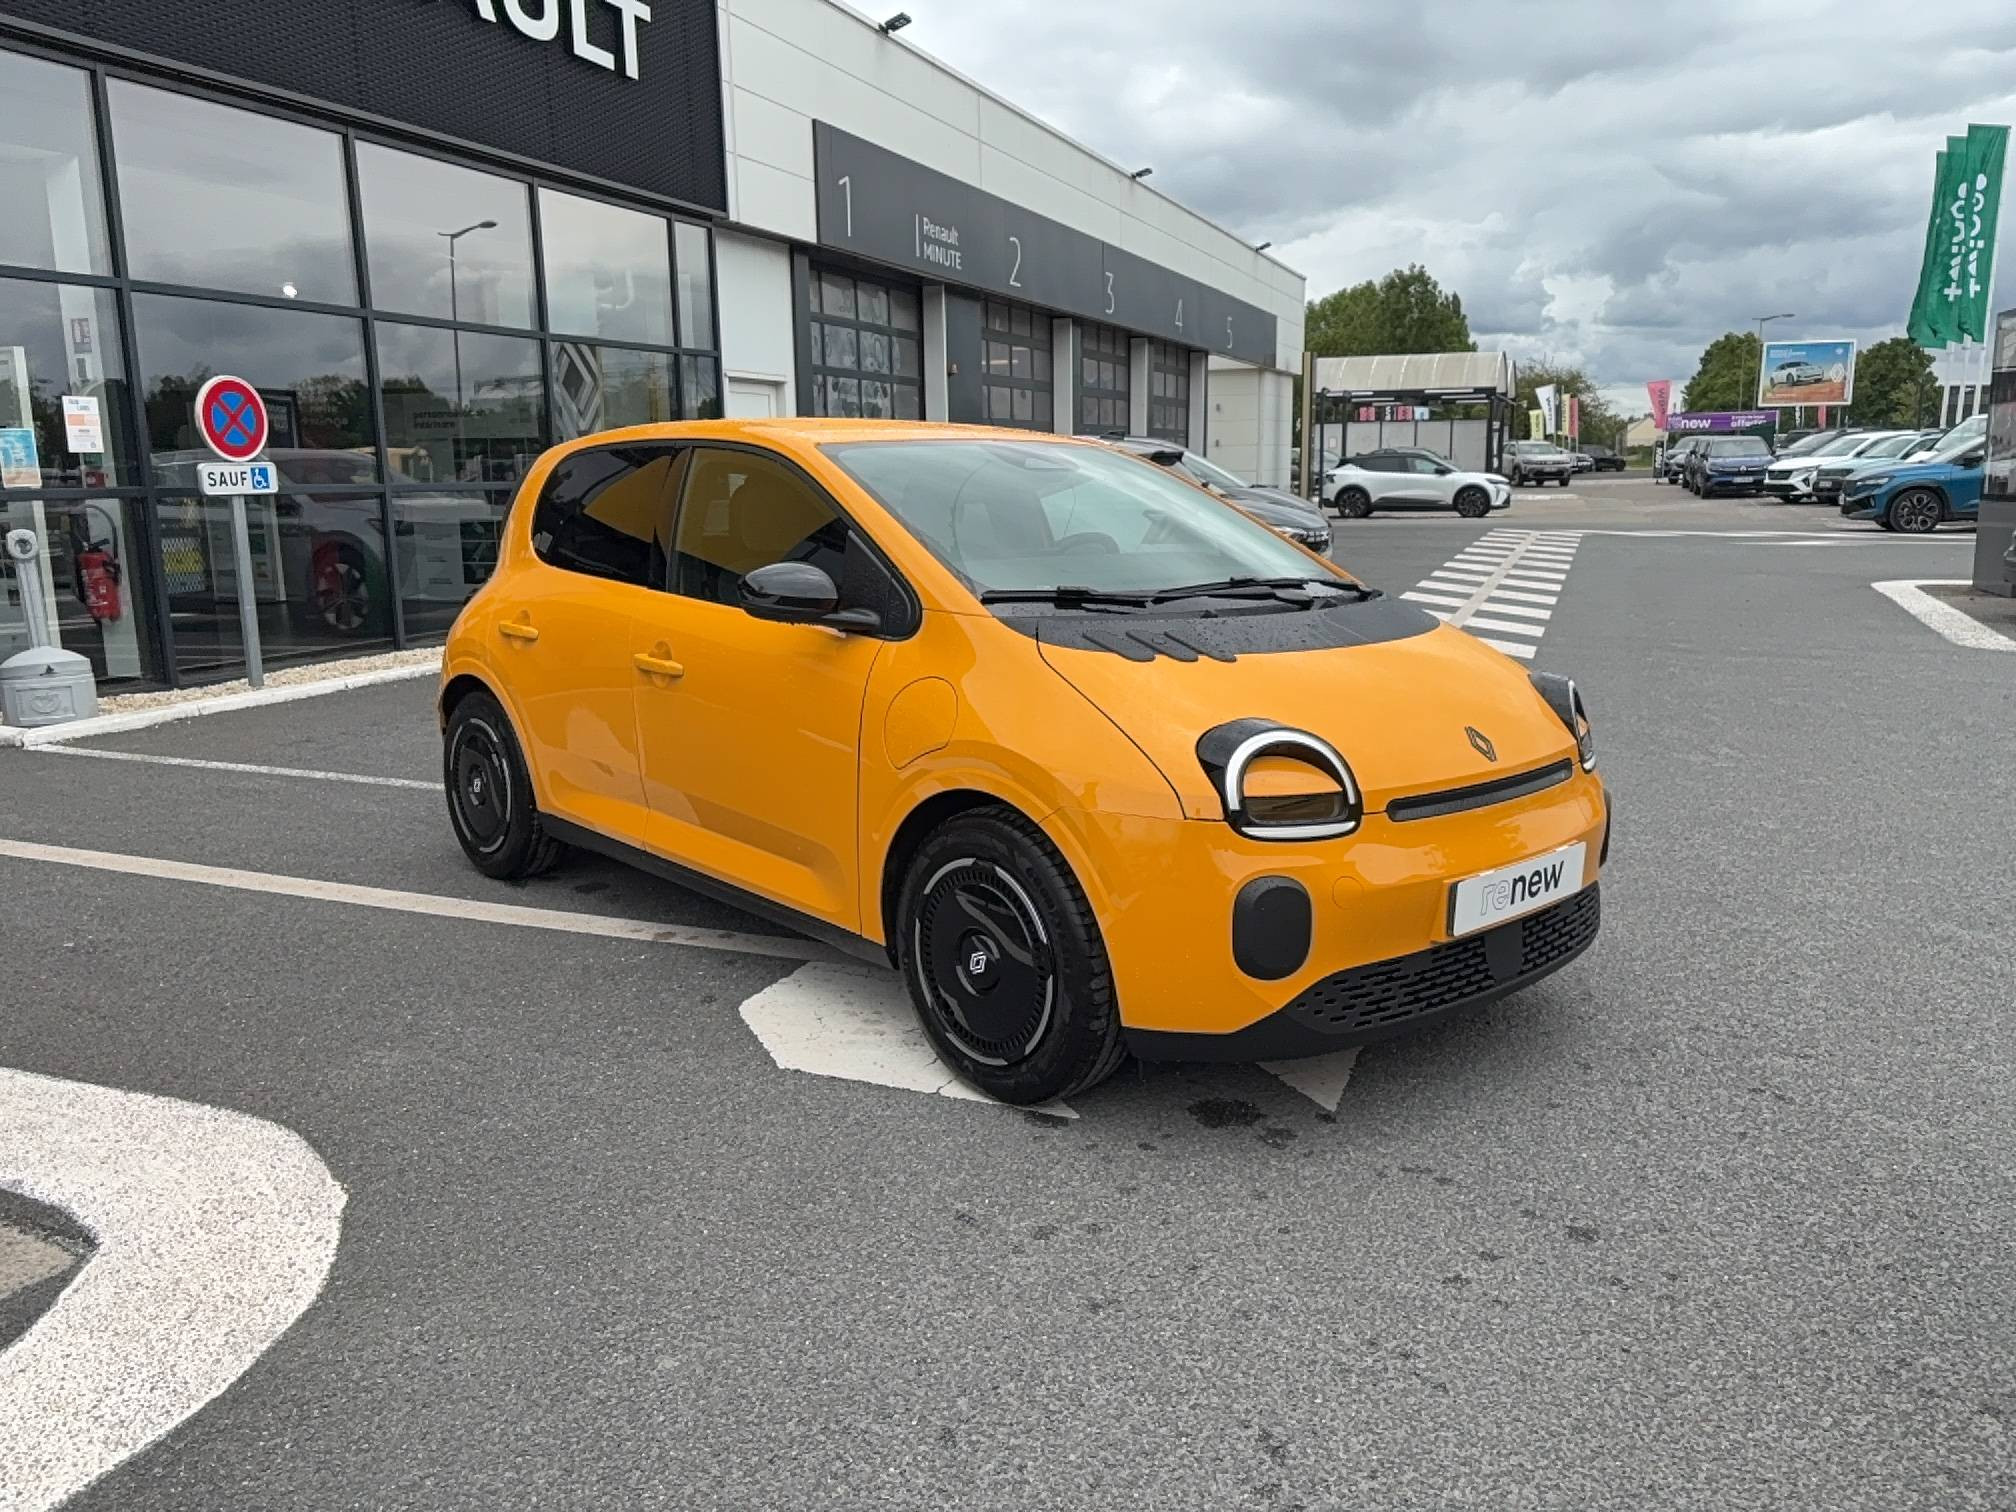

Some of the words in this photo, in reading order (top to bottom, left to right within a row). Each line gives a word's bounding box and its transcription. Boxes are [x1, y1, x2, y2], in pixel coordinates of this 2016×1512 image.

[838, 175, 851, 238] 1
[923, 216, 959, 246] Renault
[923, 241, 962, 270] MINUTE
[1009, 237, 1021, 287] 2
[1105, 271, 1114, 314] 3
[1175, 299, 1184, 335] 4
[1227, 316, 1233, 349] 5
[207, 471, 248, 487] SAUF
[1480, 860, 1564, 916] renew
